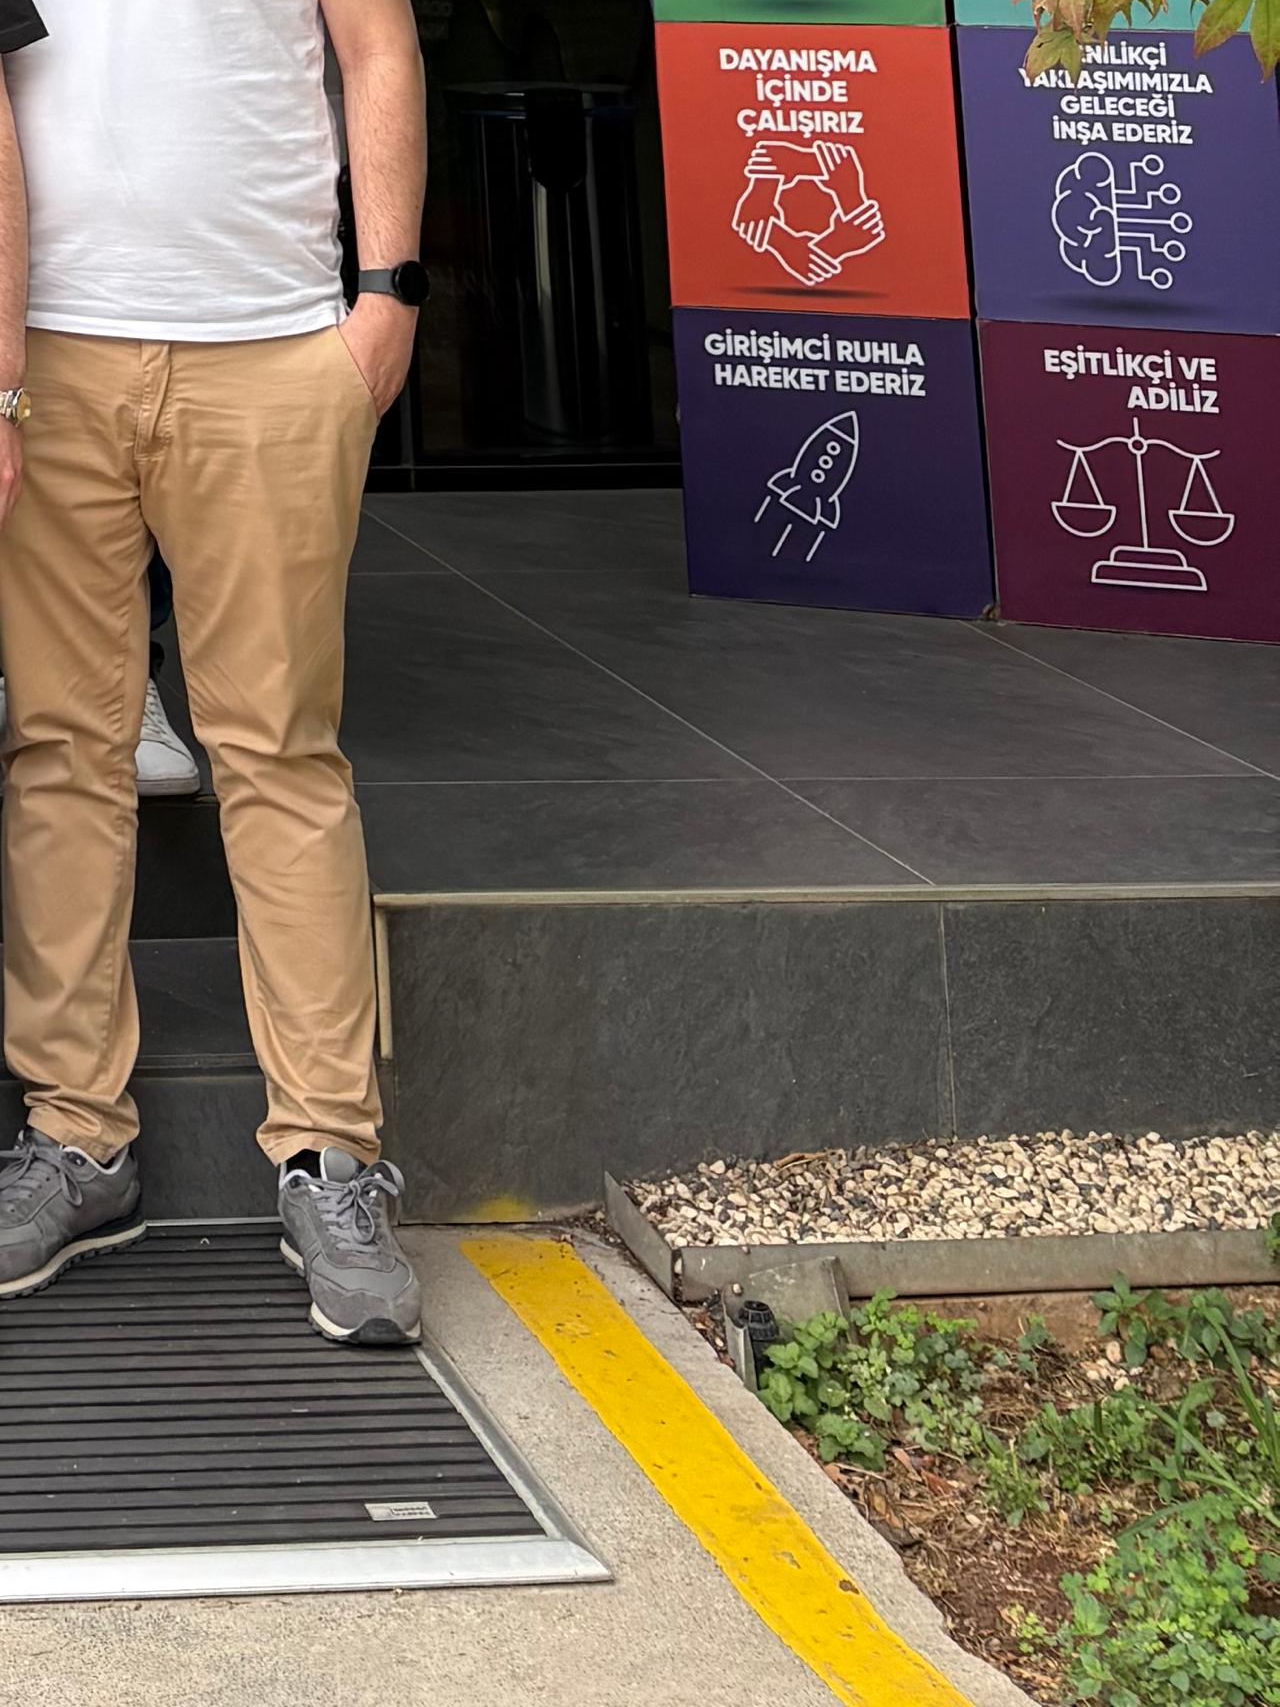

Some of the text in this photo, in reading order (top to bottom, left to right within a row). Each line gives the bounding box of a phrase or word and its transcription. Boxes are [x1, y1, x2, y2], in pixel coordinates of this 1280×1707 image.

[719, 48, 878, 77] DAYANIŞMA
[756, 73, 848, 107] İÇİNDE
[1061, 94, 1175, 118] GELECEĞİ
[736, 109, 864, 138] ÇALIŞIRIZ
[1053, 116, 1193, 145] İNŞA EDERİZ
[704, 328, 925, 367] GİRİŞİMCİ RUHLA
[714, 363, 926, 397] HAREKET EDERİZ
[1044, 345, 1217, 384] EŞİTLİKÇİ VE
[1127, 382, 1219, 414] ADİLİZ
